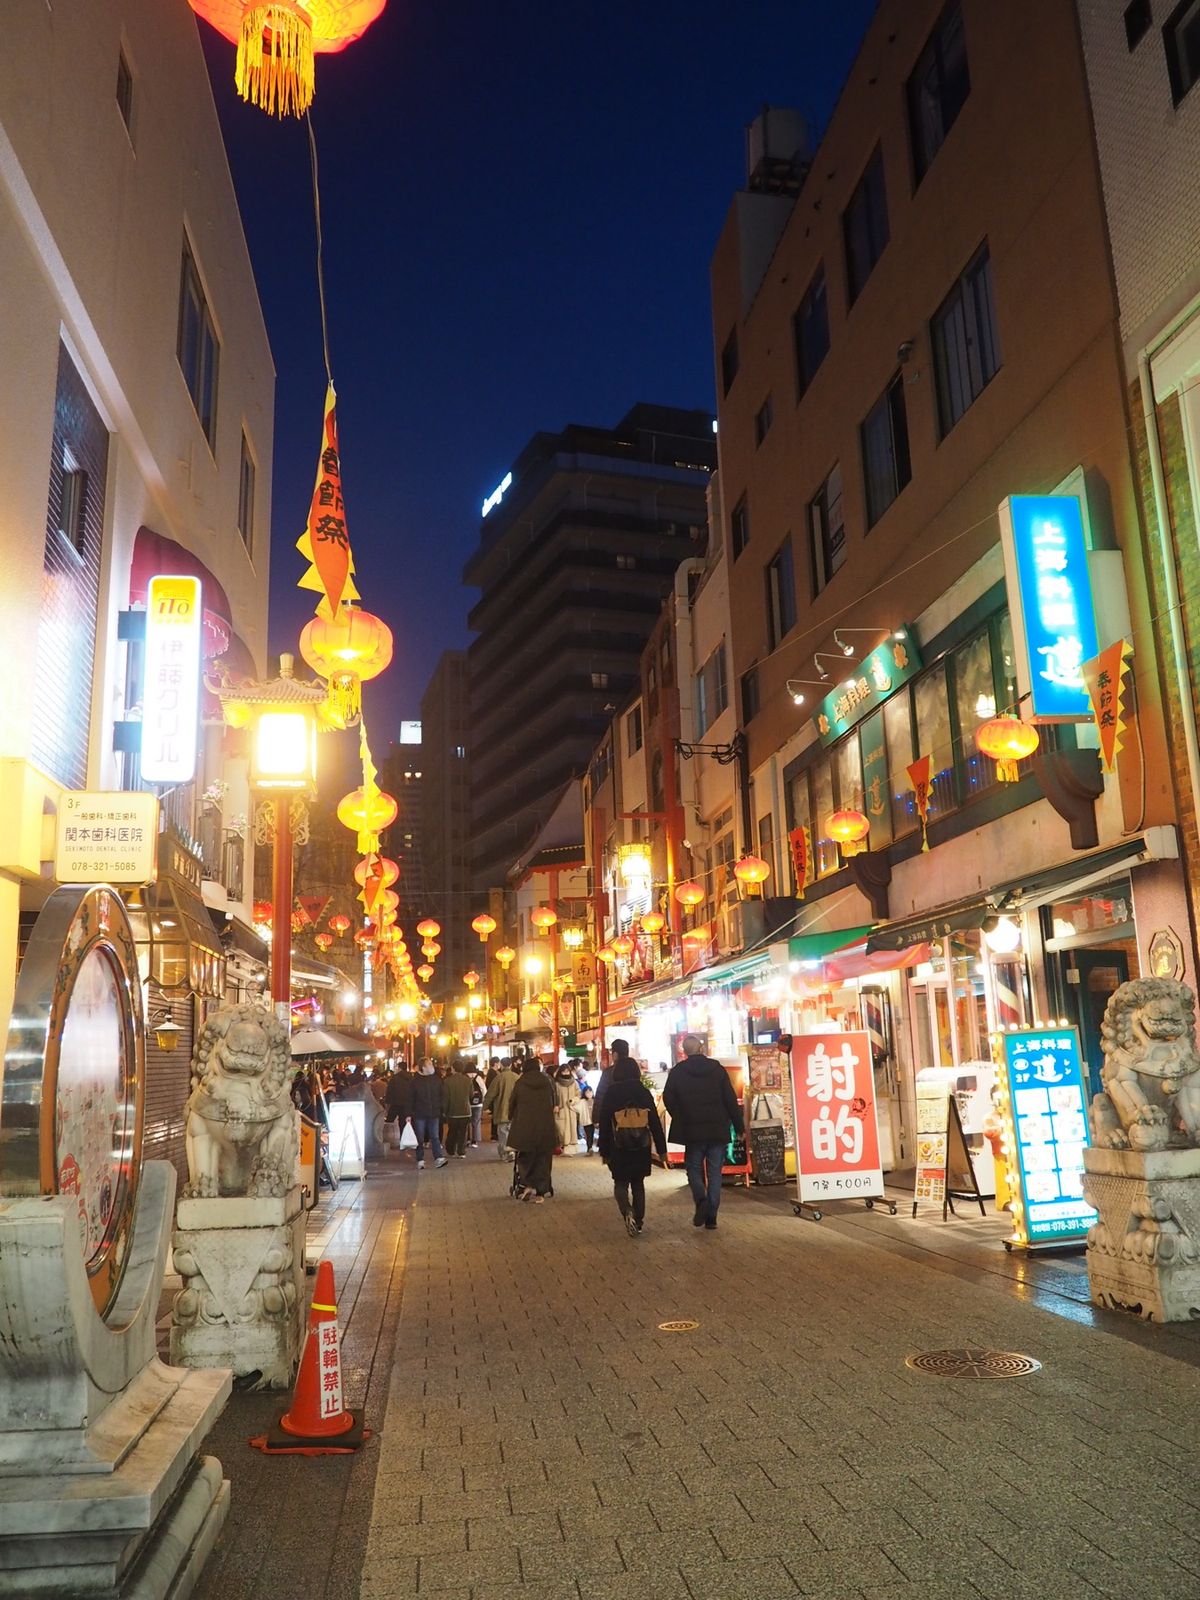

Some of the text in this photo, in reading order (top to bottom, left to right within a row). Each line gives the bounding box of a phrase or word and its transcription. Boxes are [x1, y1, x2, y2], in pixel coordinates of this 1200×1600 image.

[1097, 670, 1115, 728] 春節祭
[65, 827, 143, 841] 関本歯科医院
[805, 1042, 864, 1164] 射的
[322, 1326, 339, 1414] 駐輪禁止
